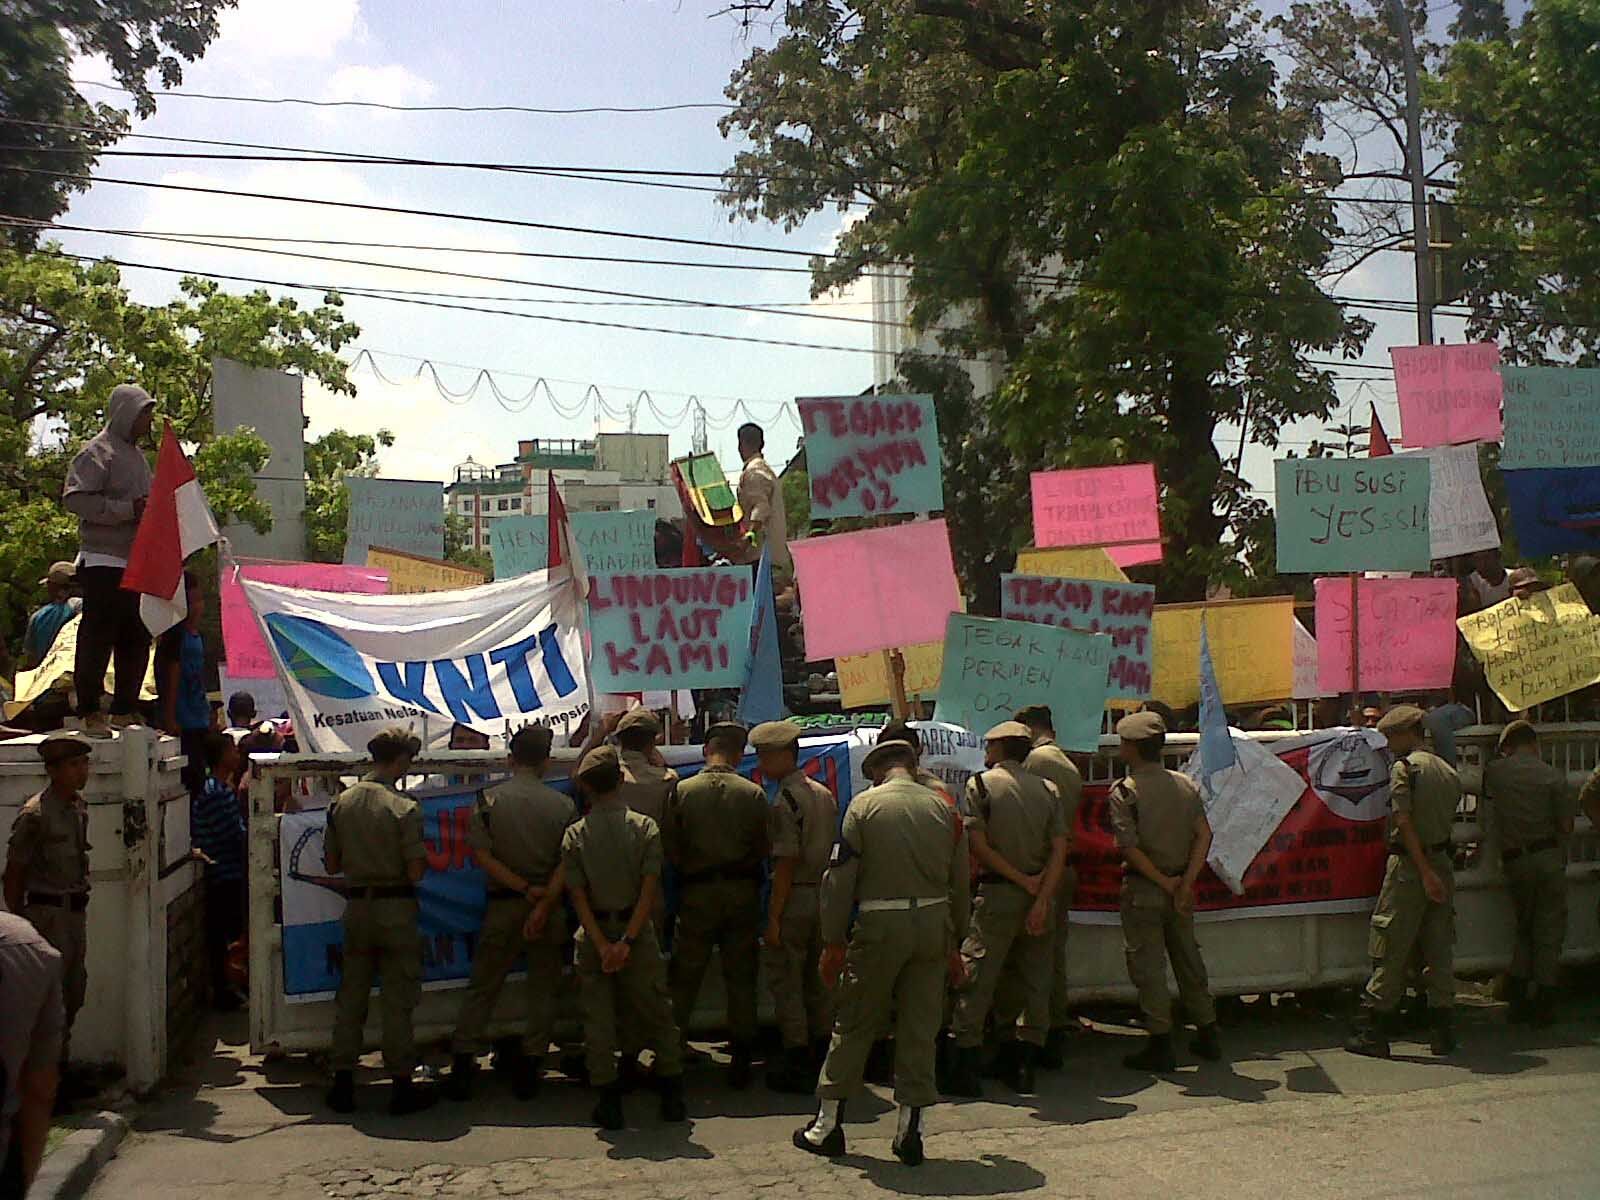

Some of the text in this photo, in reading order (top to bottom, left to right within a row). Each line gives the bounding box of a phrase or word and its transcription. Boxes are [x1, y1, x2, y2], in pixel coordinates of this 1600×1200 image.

[587, 571, 749, 611] LINDUNGI
[630, 606, 722, 644] LAUT
[375, 622, 578, 725] KNTI
[604, 641, 729, 676] KAMI
[313, 708, 384, 729] Kesatuan
[973, 692, 1015, 713] 02
